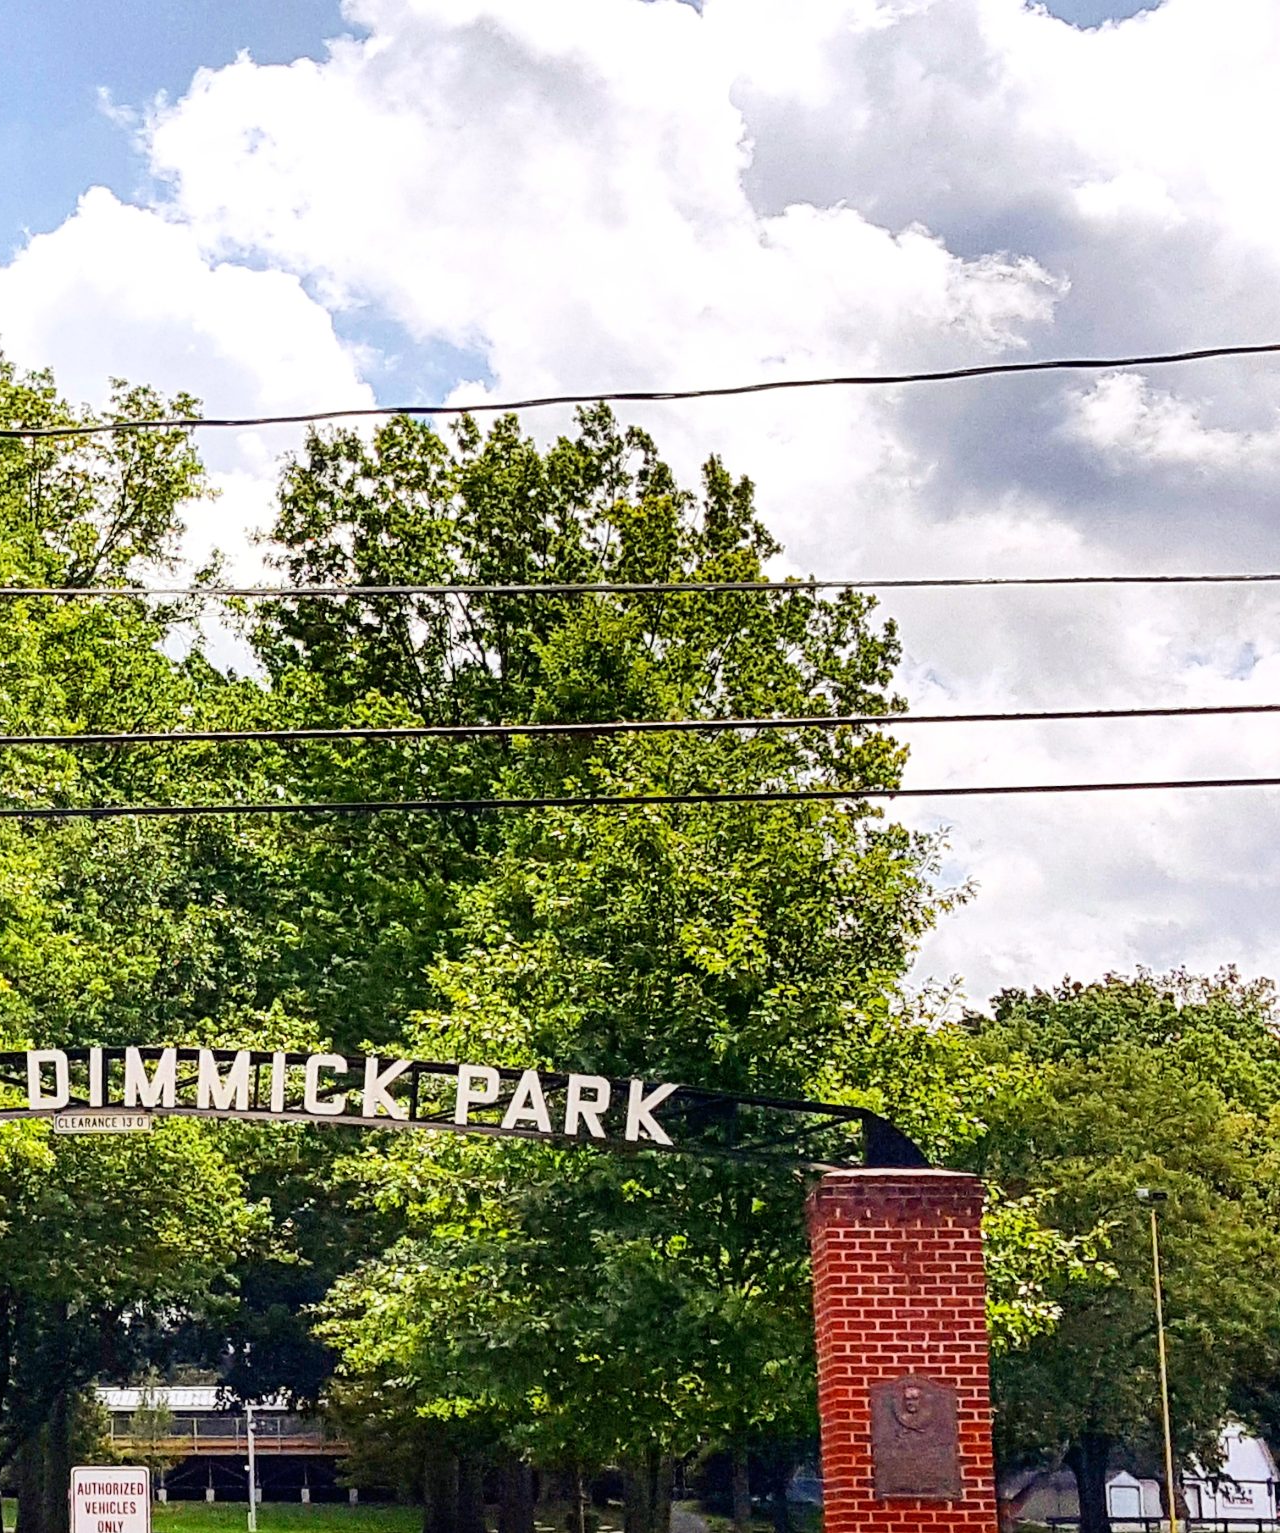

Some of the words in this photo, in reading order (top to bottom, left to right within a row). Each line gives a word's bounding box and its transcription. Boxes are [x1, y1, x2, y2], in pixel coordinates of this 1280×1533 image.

[26, 1043, 416, 1121] DIMMICK
[452, 1064, 680, 1146] PARK
[58, 1117, 117, 1128] CLEARANCE
[77, 1483, 144, 1495] AUTHORIZED
[85, 1502, 137, 1514] VEHICLES
[97, 1520, 124, 1533] ONLY
